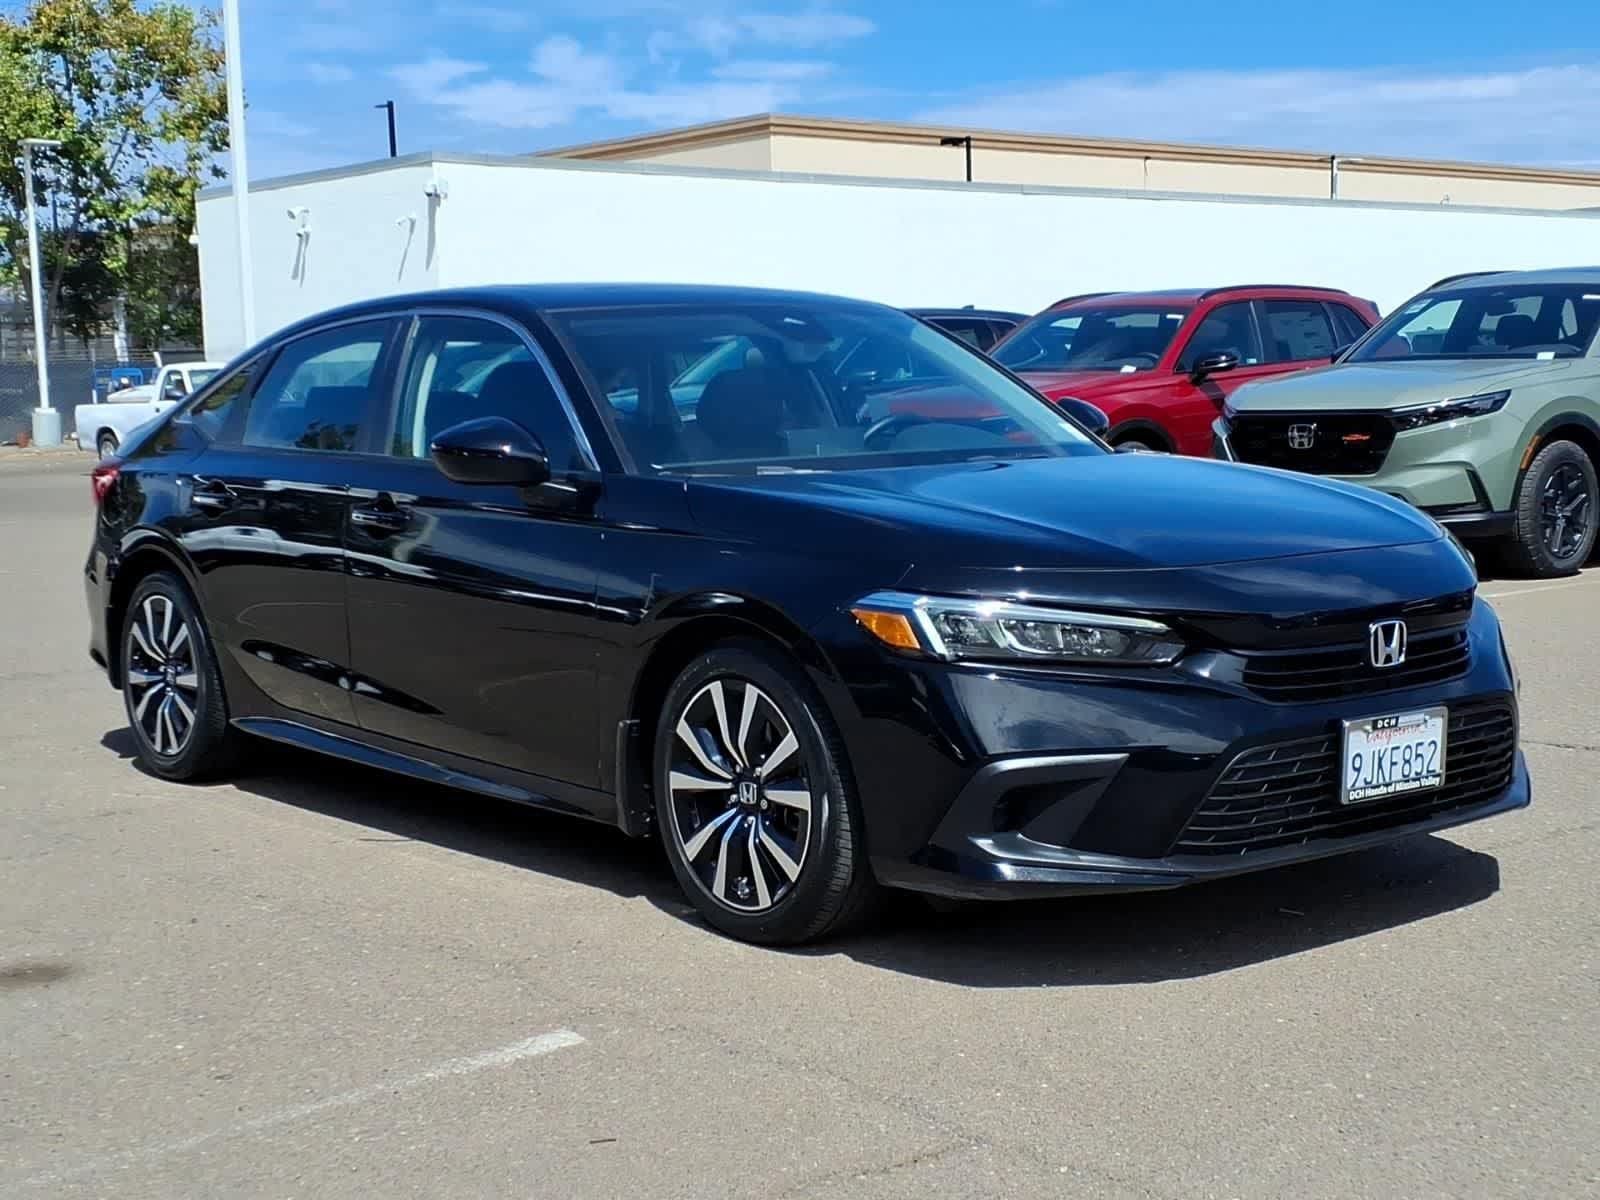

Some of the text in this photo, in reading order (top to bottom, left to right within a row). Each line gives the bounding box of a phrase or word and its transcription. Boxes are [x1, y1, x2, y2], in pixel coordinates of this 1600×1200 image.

[1377, 718, 1397, 728] DCH
[1351, 740, 1437, 788] 9JKF852
[1349, 789, 1364, 800] DCH
[1365, 786, 1387, 797] Honda
[1388, 783, 1395, 792] of
